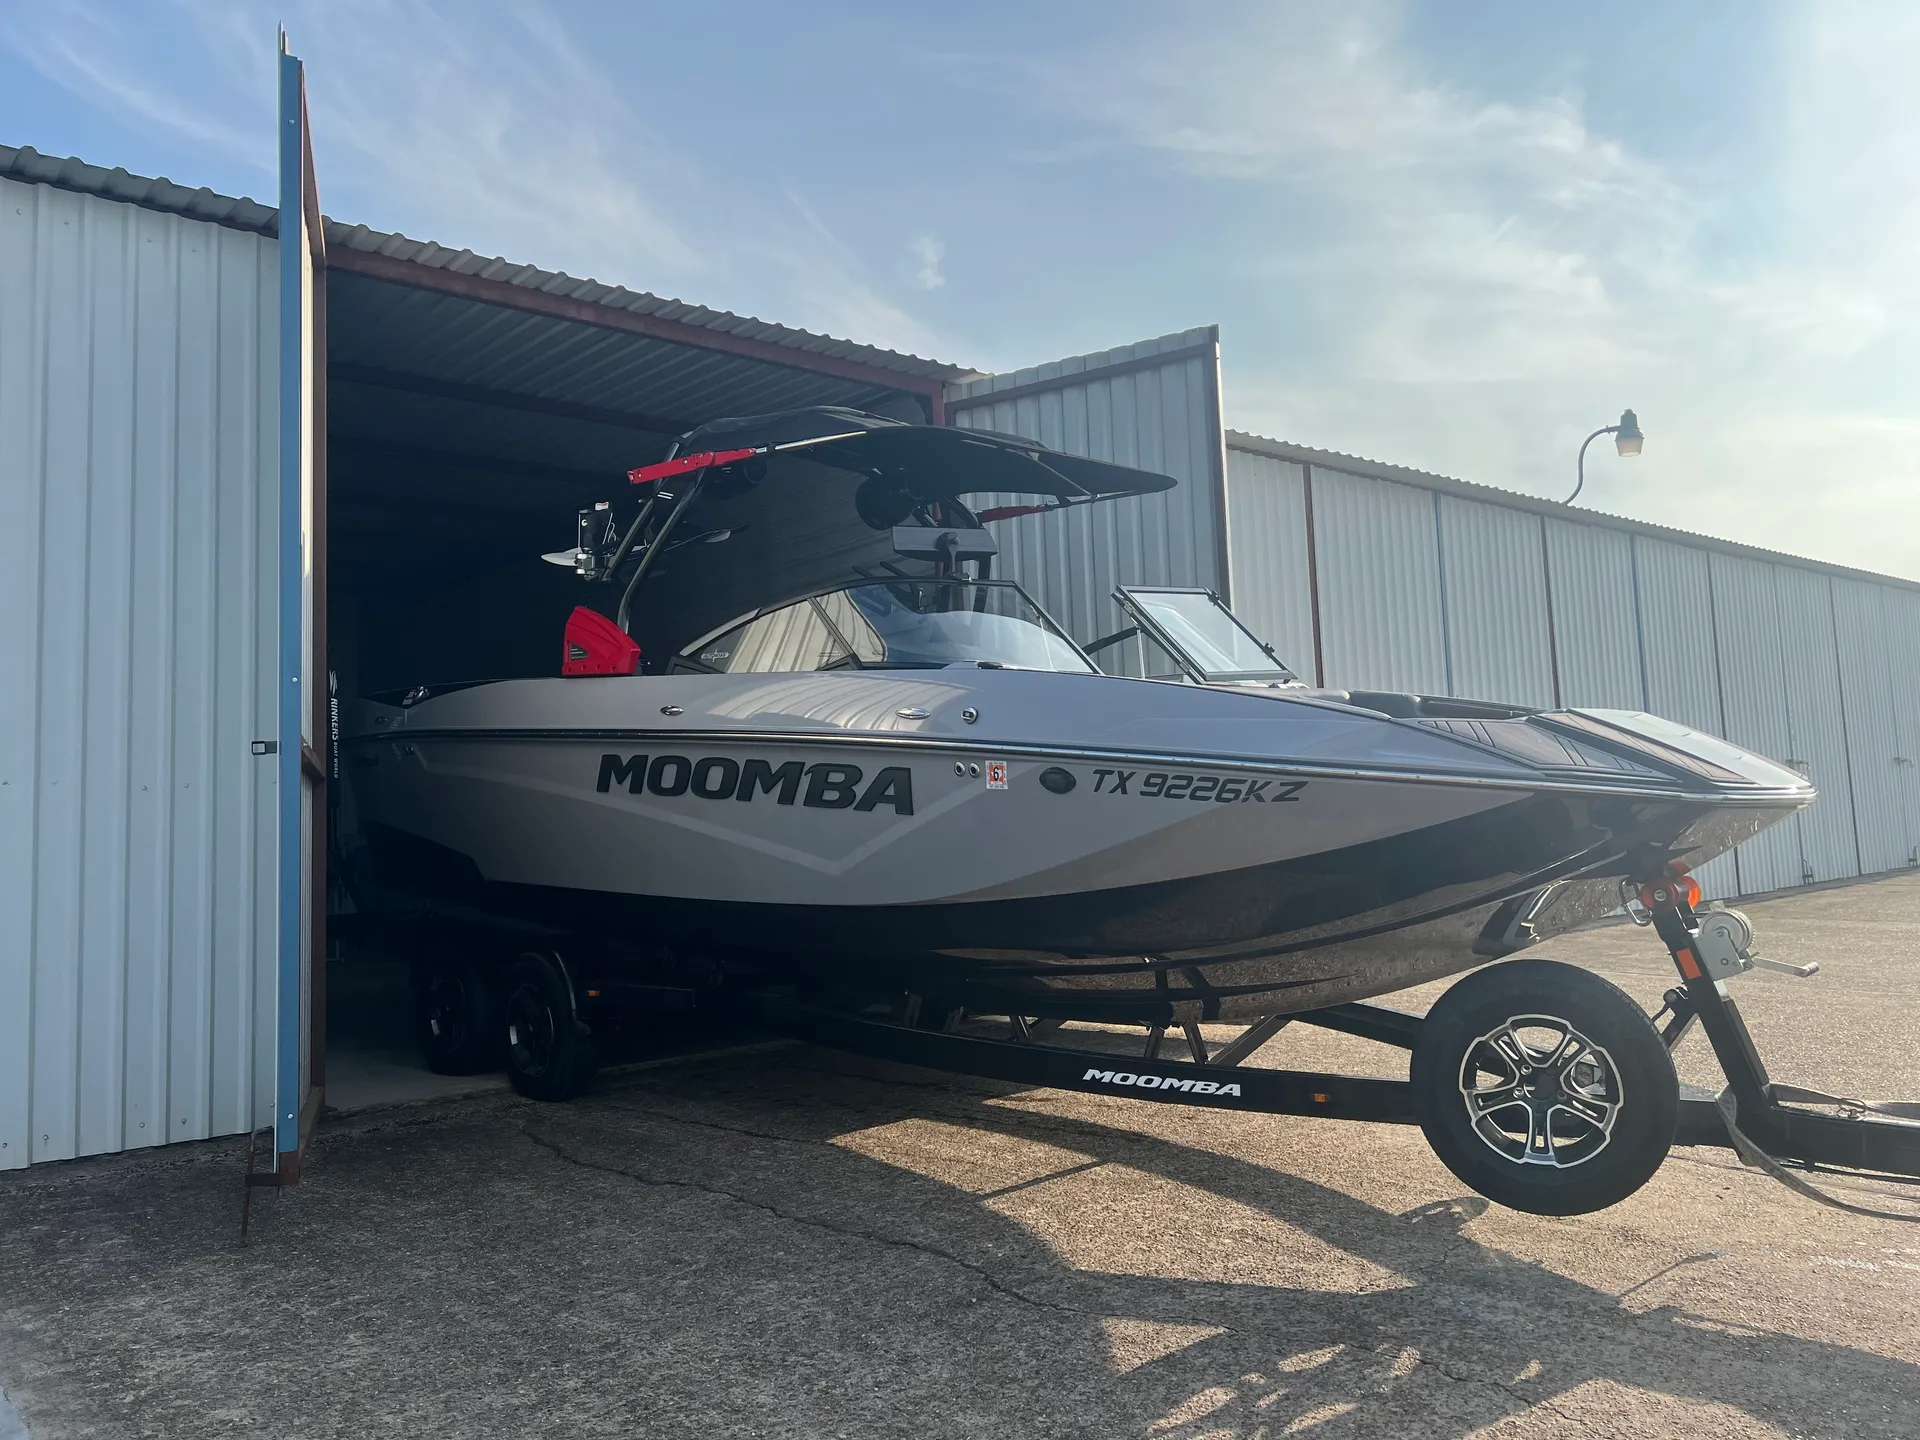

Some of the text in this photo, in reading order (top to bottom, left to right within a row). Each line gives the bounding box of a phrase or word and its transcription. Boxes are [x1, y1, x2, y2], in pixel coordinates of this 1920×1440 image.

[331, 698, 339, 741] RINKERS
[596, 754, 914, 816] MOOMBA
[1092, 769, 1309, 803] TX 9226KZ
[1083, 1069, 1241, 1097] MOOMBA
